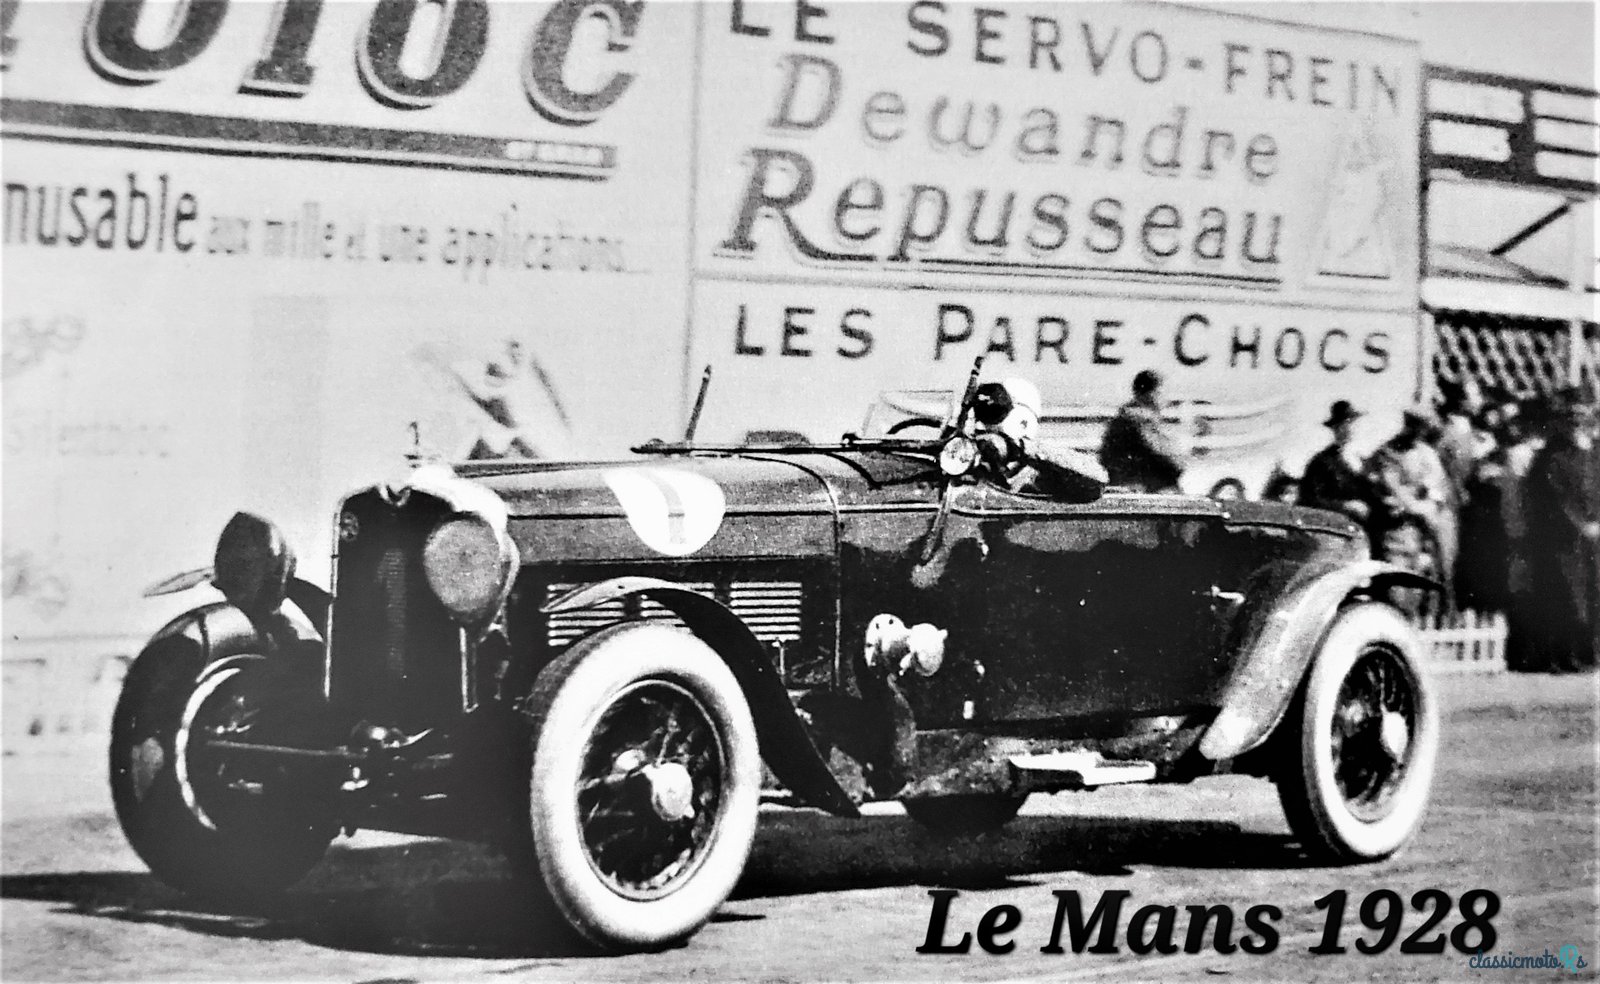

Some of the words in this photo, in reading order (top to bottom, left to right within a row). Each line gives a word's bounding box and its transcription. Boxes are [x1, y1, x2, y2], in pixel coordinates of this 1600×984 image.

[730, 0, 836, 45] LE
[906, 0, 1400, 114] SERVO-FREIN
[766, 52, 1281, 178] Dewandre
[716, 147, 1283, 268] Repusseau
[733, 302, 875, 360] LES
